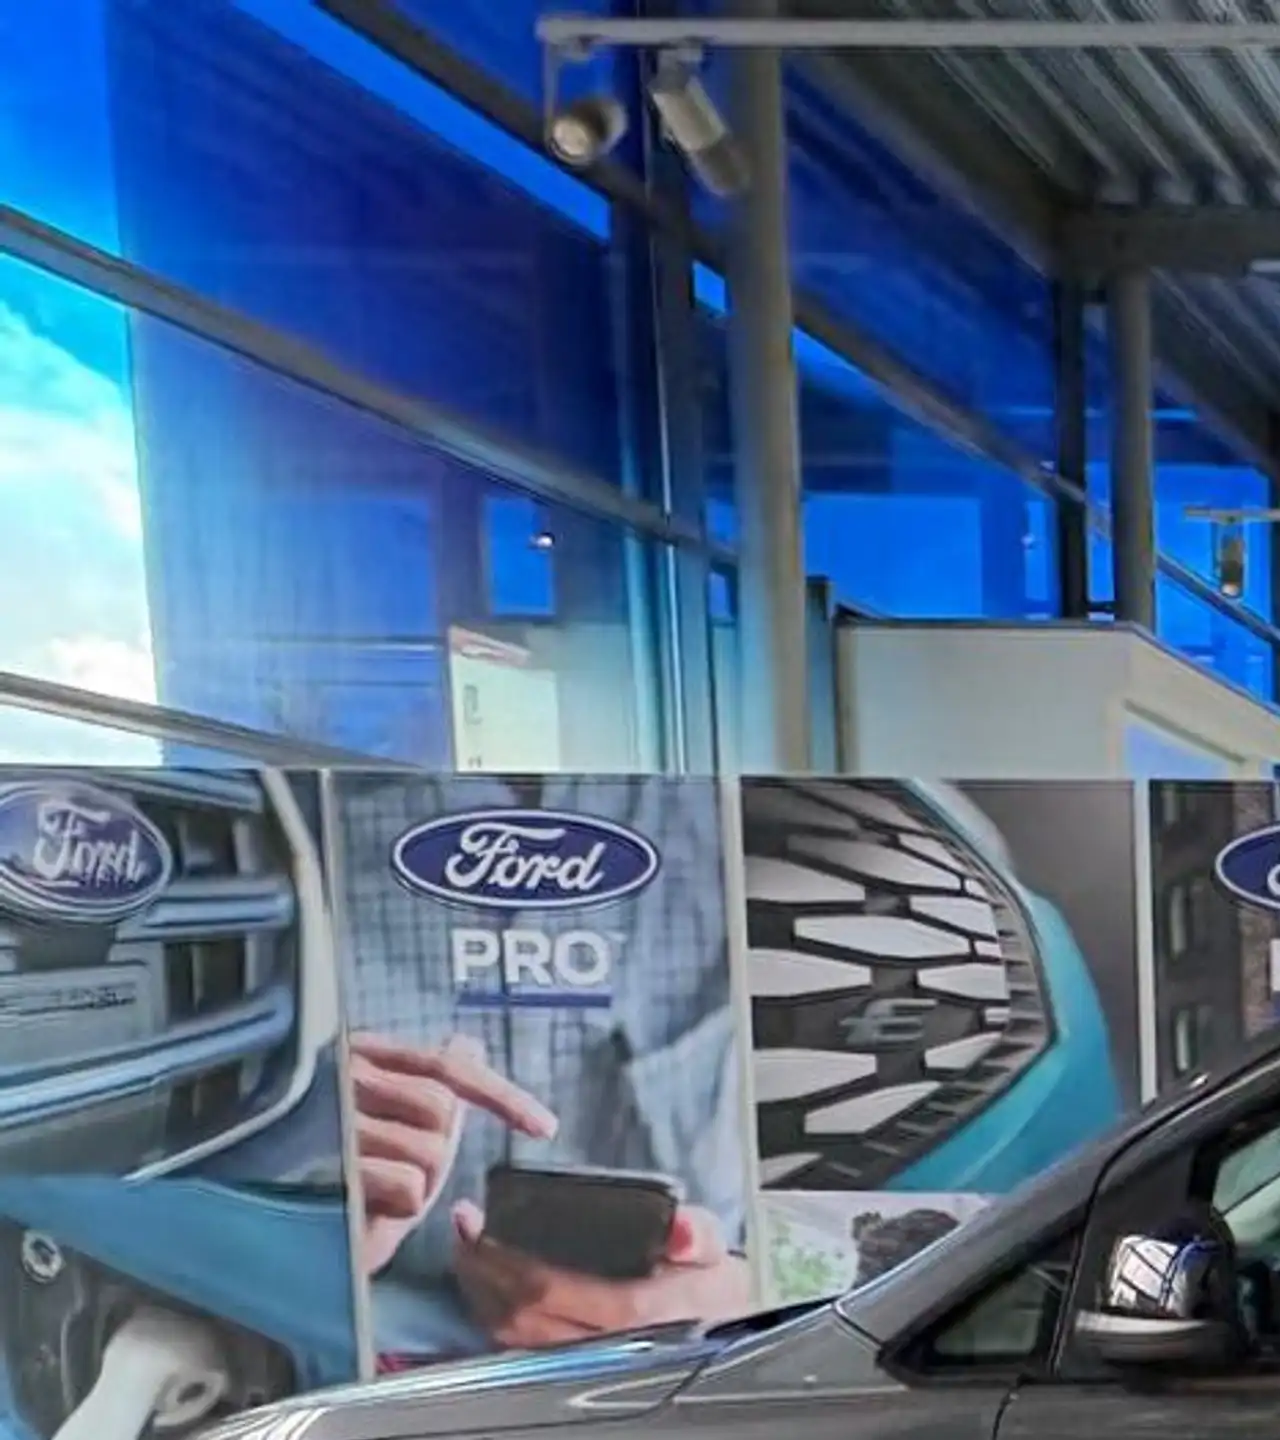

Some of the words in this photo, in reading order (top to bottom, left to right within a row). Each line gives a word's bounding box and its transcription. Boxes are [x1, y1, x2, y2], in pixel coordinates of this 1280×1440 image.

[33, 800, 147, 884] Ford
[444, 822, 606, 890] Ford
[451, 928, 610, 986] PRO
